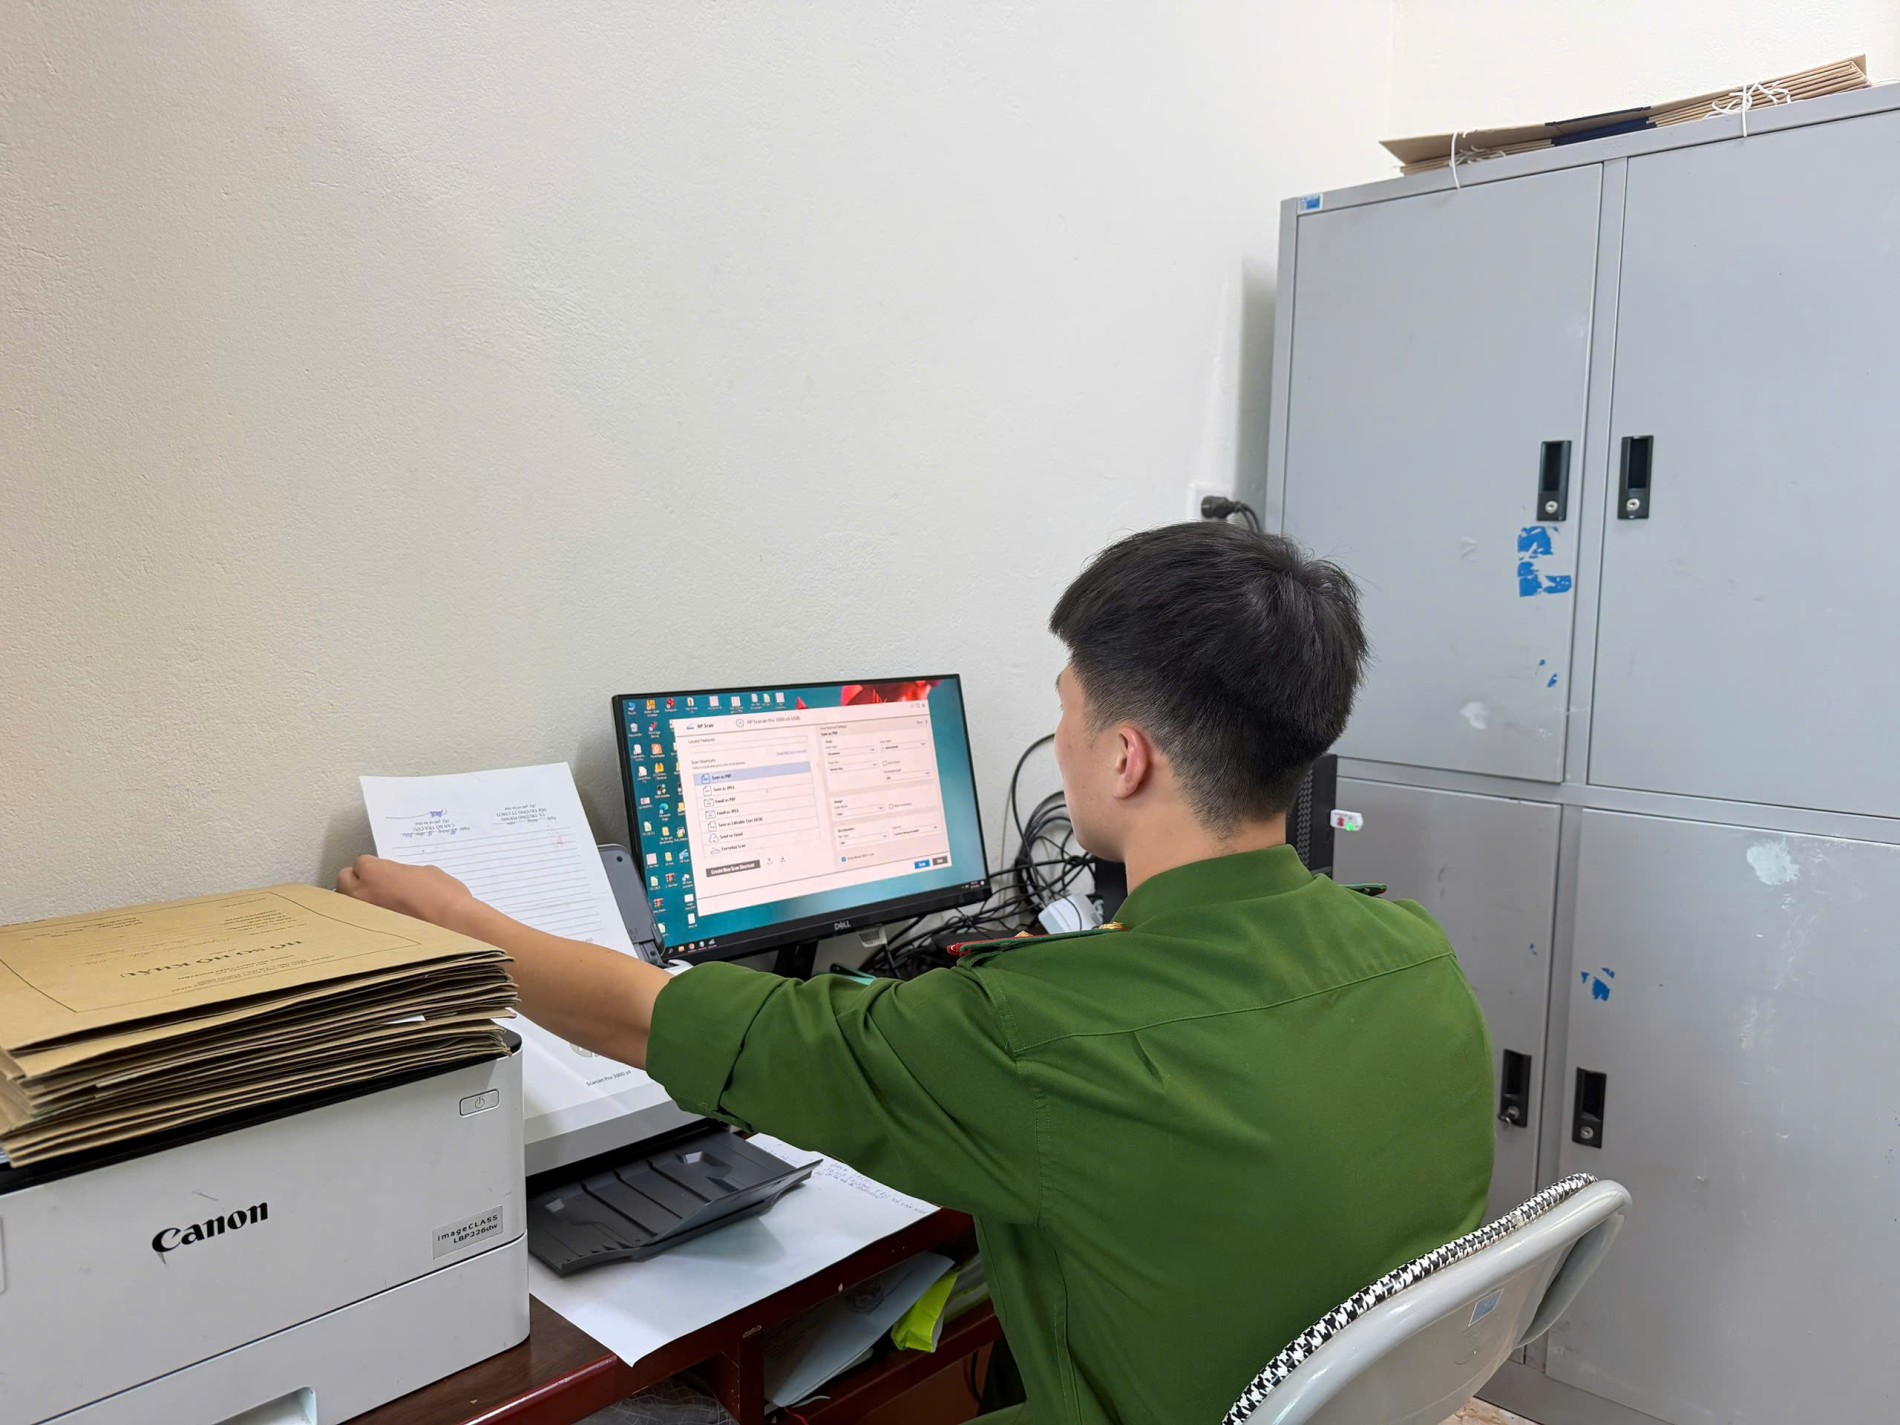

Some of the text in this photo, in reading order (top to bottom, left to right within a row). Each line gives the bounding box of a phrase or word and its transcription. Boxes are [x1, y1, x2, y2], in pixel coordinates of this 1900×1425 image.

[834, 921, 851, 931] DELL
[586, 1078, 604, 1087] ScanJet
[152, 1202, 268, 1253] Canon
[437, 1214, 498, 1242] imageCLASS
[453, 1223, 498, 1244] LBP226dw
